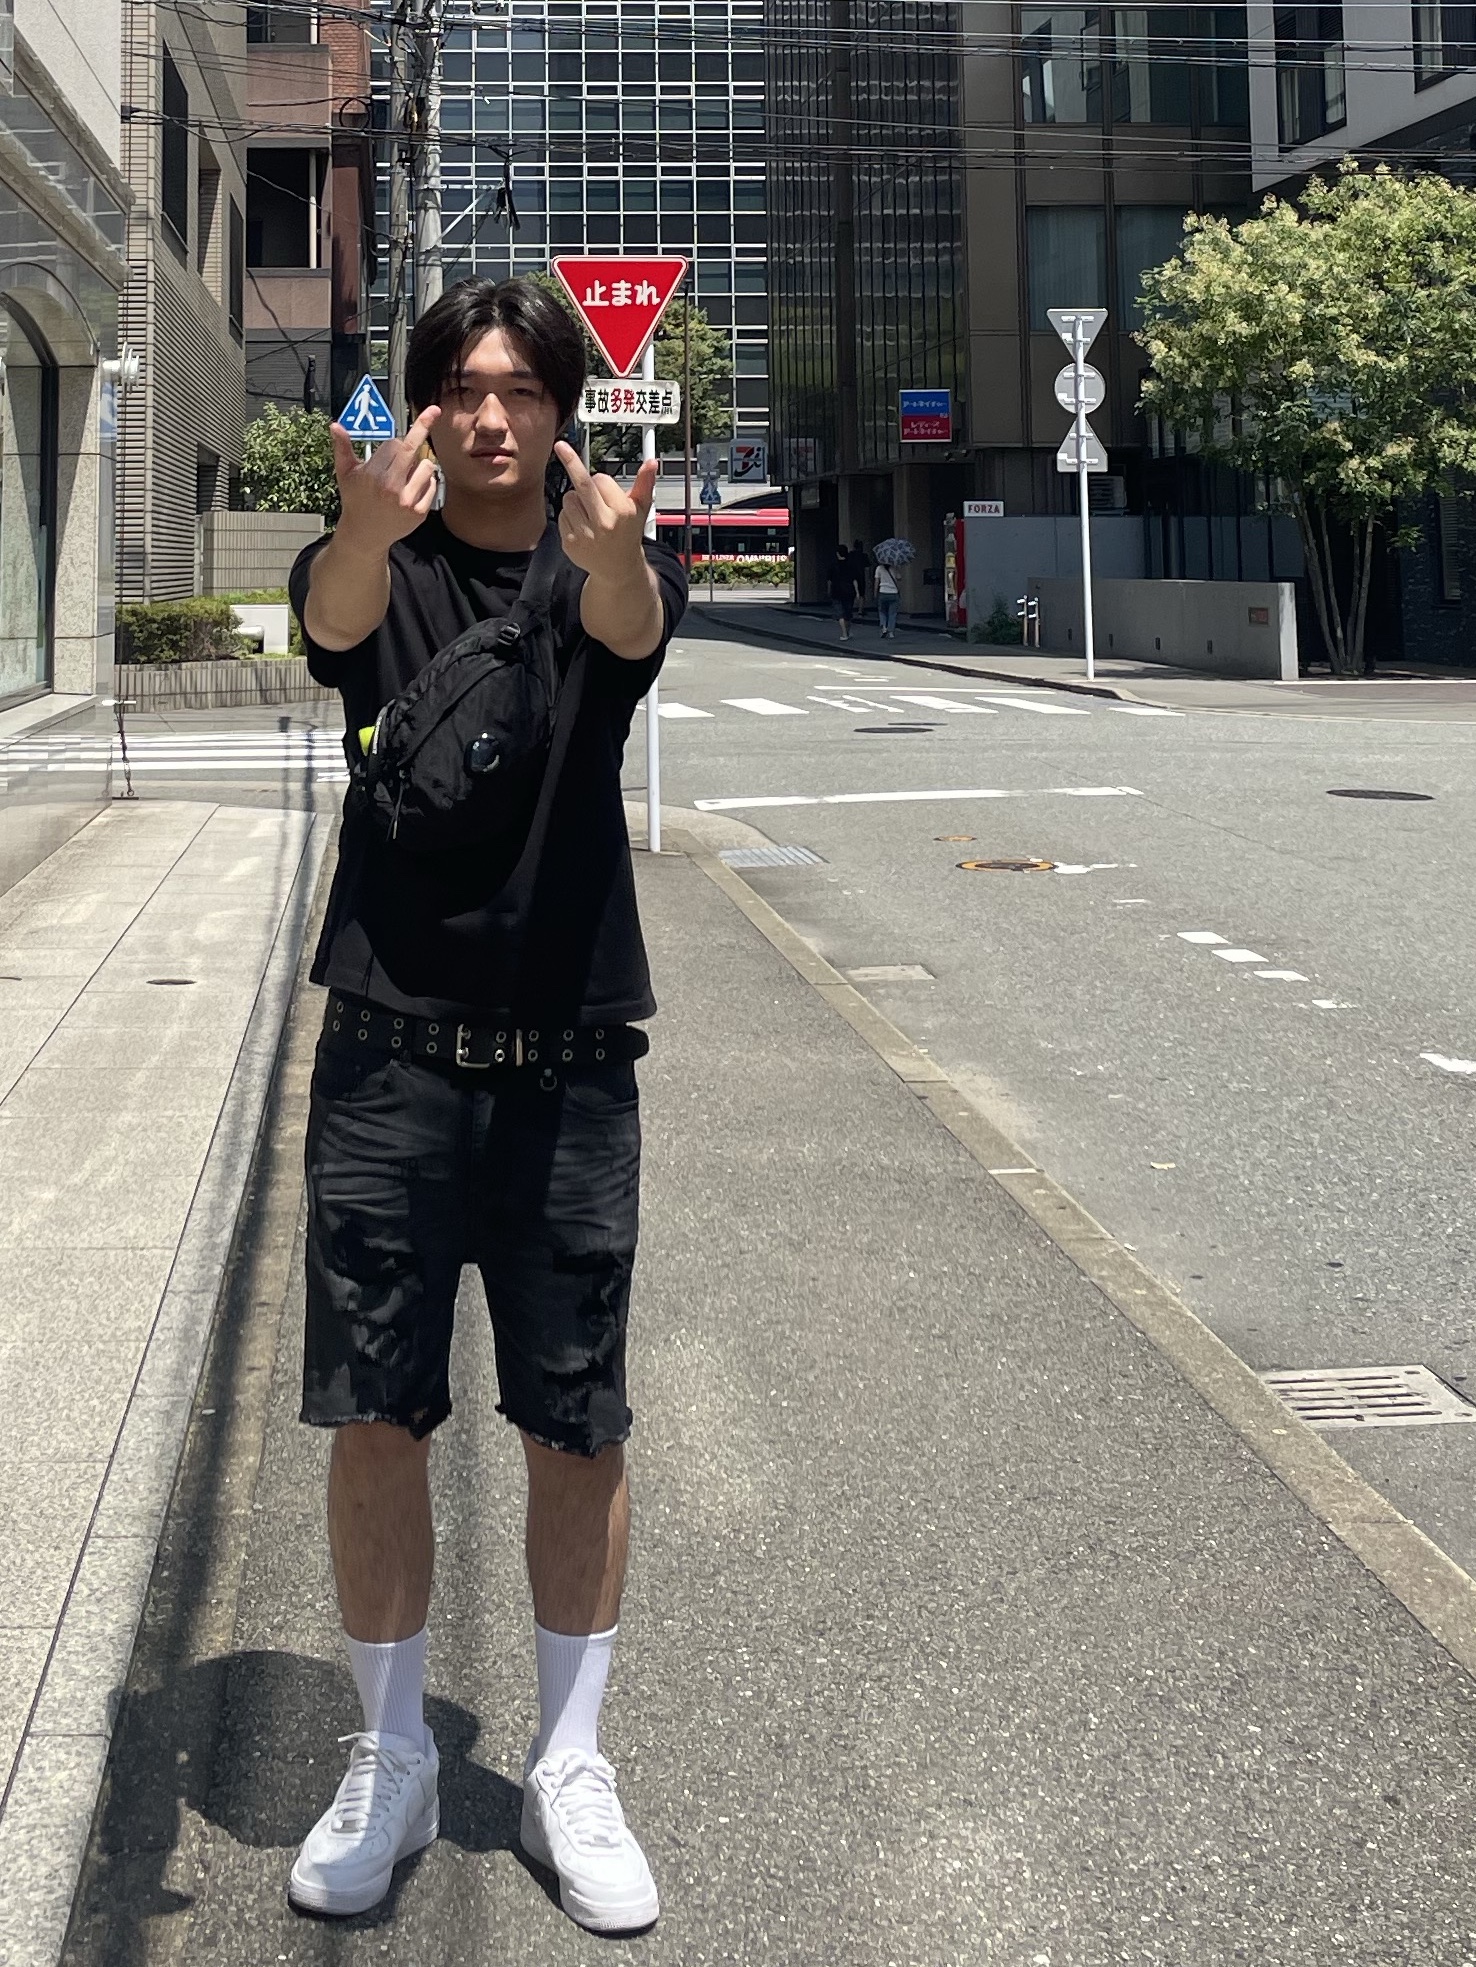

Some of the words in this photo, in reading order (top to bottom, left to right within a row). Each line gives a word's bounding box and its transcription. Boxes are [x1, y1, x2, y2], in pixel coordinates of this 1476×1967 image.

[582, 279, 661, 307] 止まれ
[584, 388, 674, 415] 事故多発交差点
[968, 504, 1000, 513] FORZA
